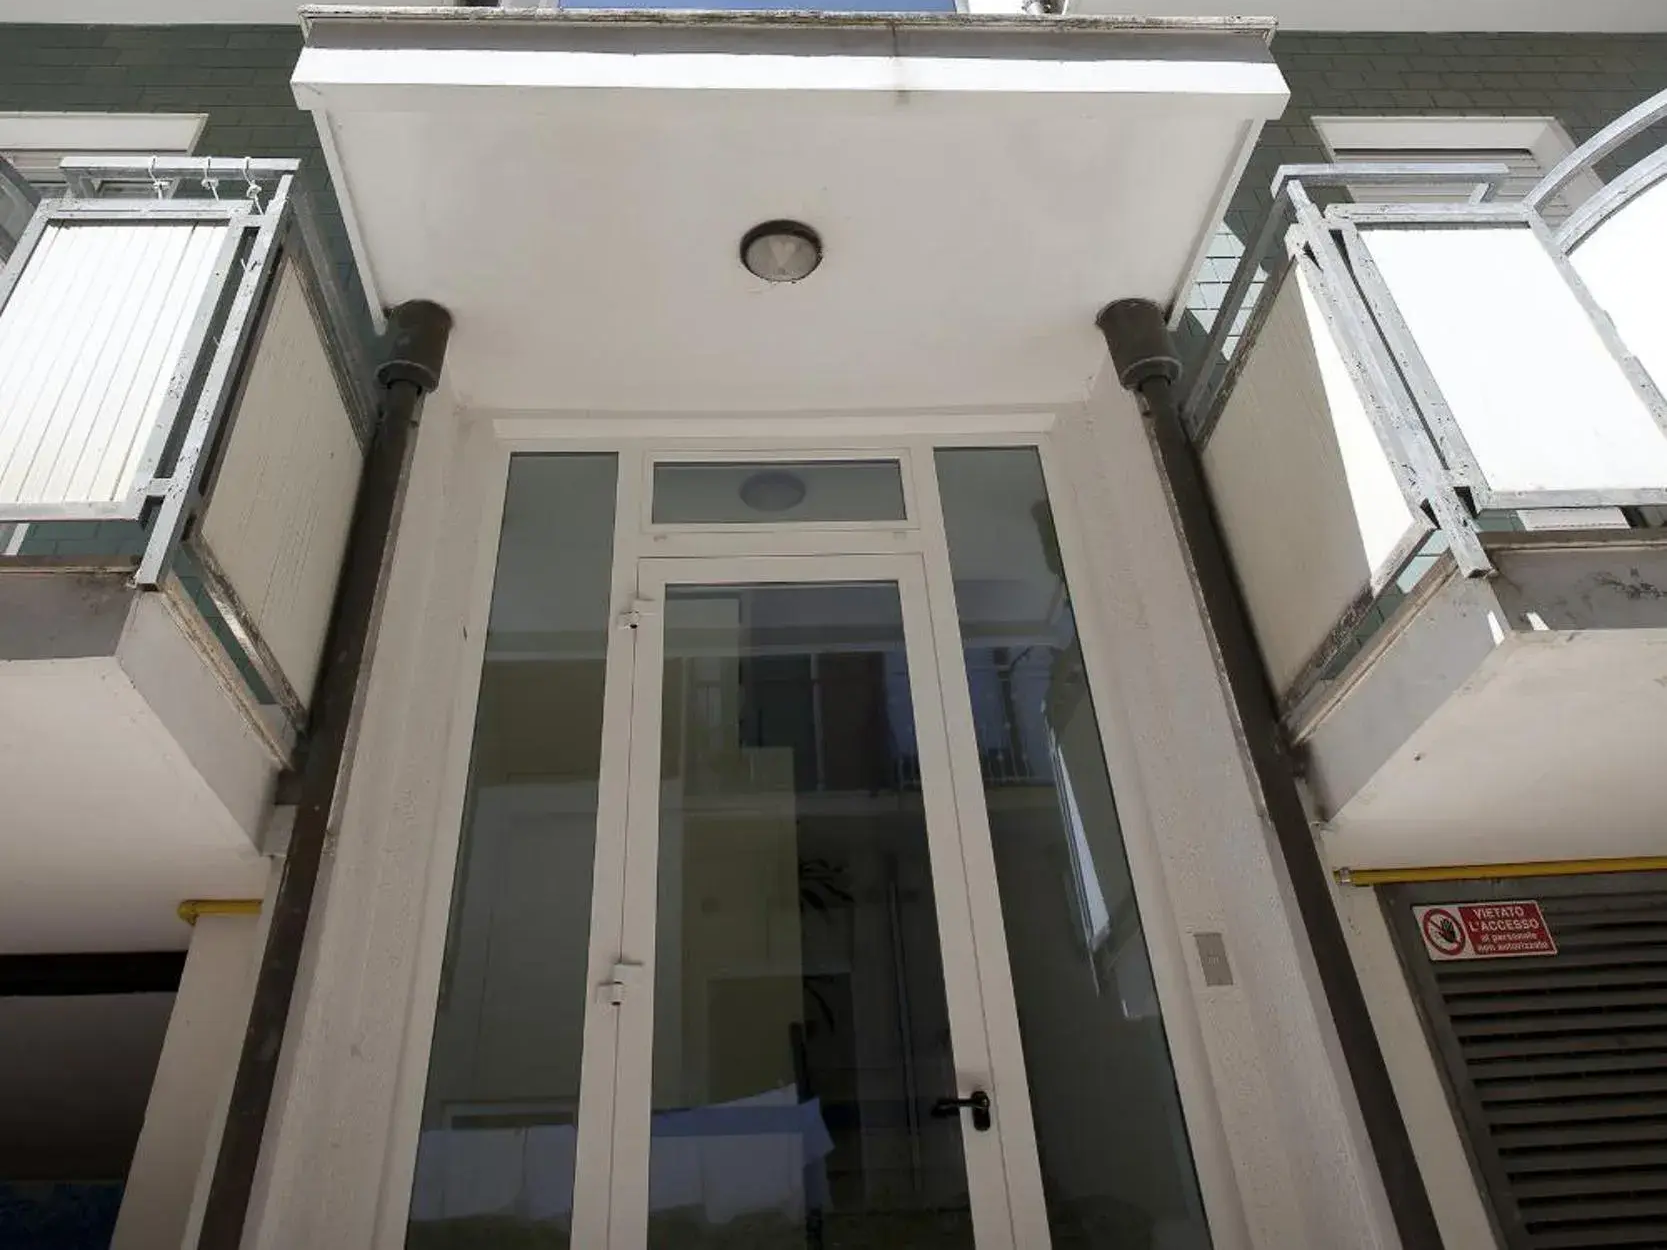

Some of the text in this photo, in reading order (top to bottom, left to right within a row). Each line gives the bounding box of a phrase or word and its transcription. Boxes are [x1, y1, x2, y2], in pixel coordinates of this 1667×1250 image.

[1473, 906, 1524, 919] VIETATO
[1469, 918, 1540, 932] L'ACCESSO
[1492, 932, 1537, 943] personale
[1478, 941, 1549, 952] non autorizzato
